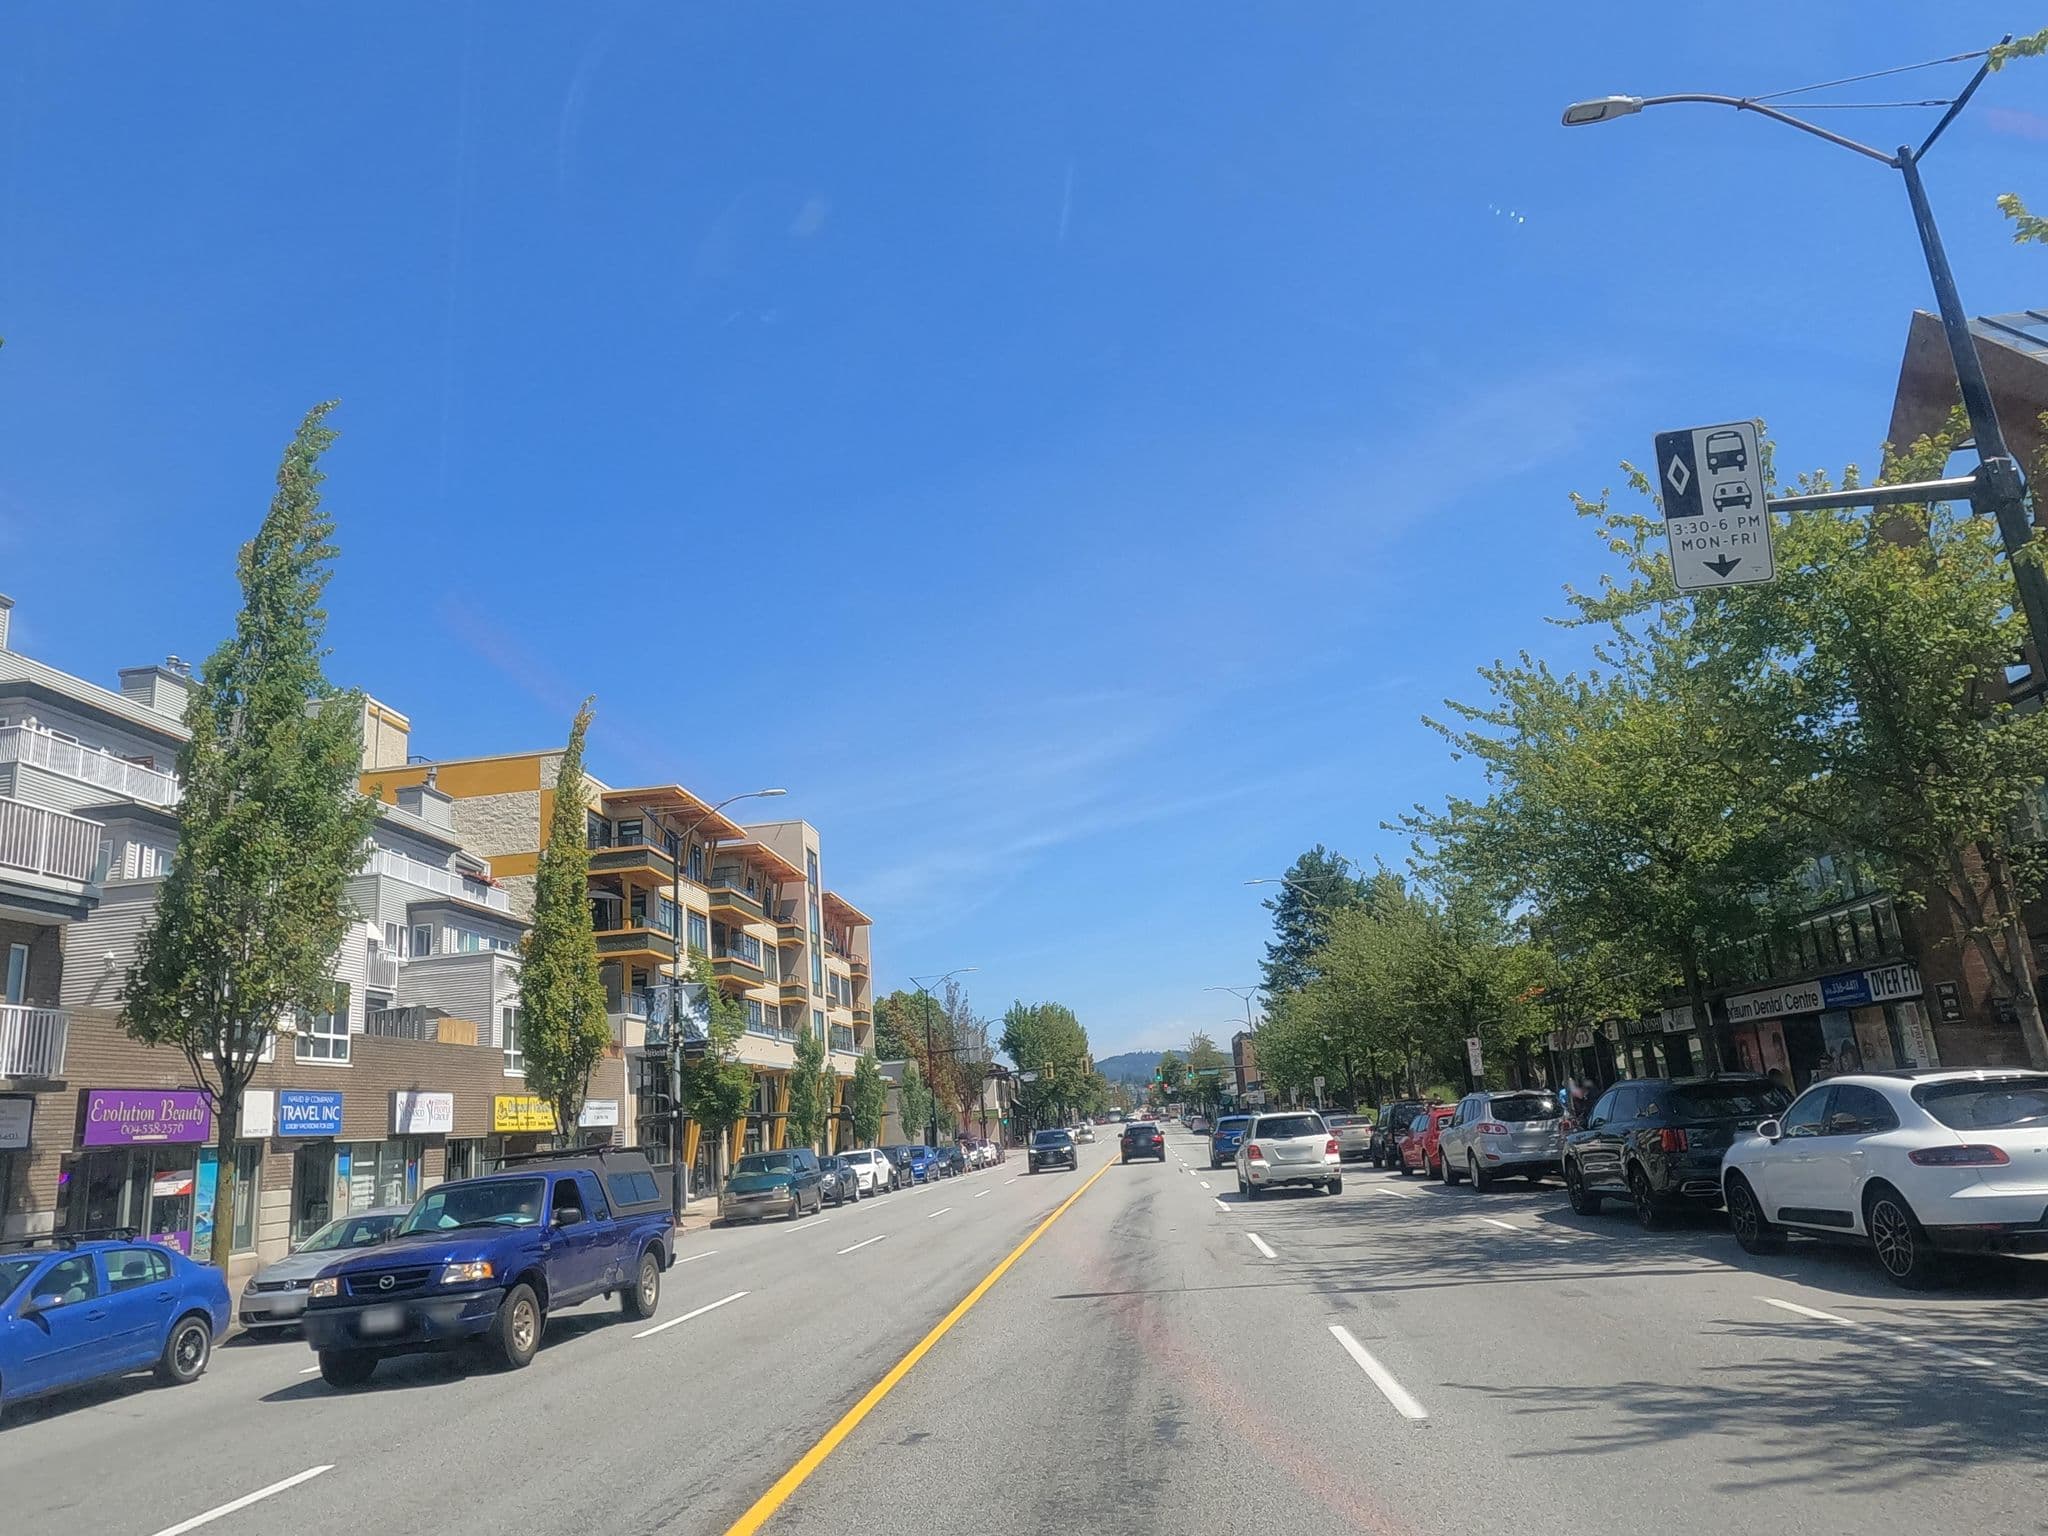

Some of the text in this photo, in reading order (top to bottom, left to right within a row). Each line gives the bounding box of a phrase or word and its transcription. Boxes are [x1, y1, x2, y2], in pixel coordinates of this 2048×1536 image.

[1673, 515, 1761, 536] 3:30-6 PM
[1681, 532, 1758, 551] MON-FRI
[1753, 995, 1783, 1015] Dental
[1784, 990, 1819, 1011] Centre
[91, 1098, 205, 1125] Evolution Beauty
[282, 1105, 340, 1121] TRAVEL INC
